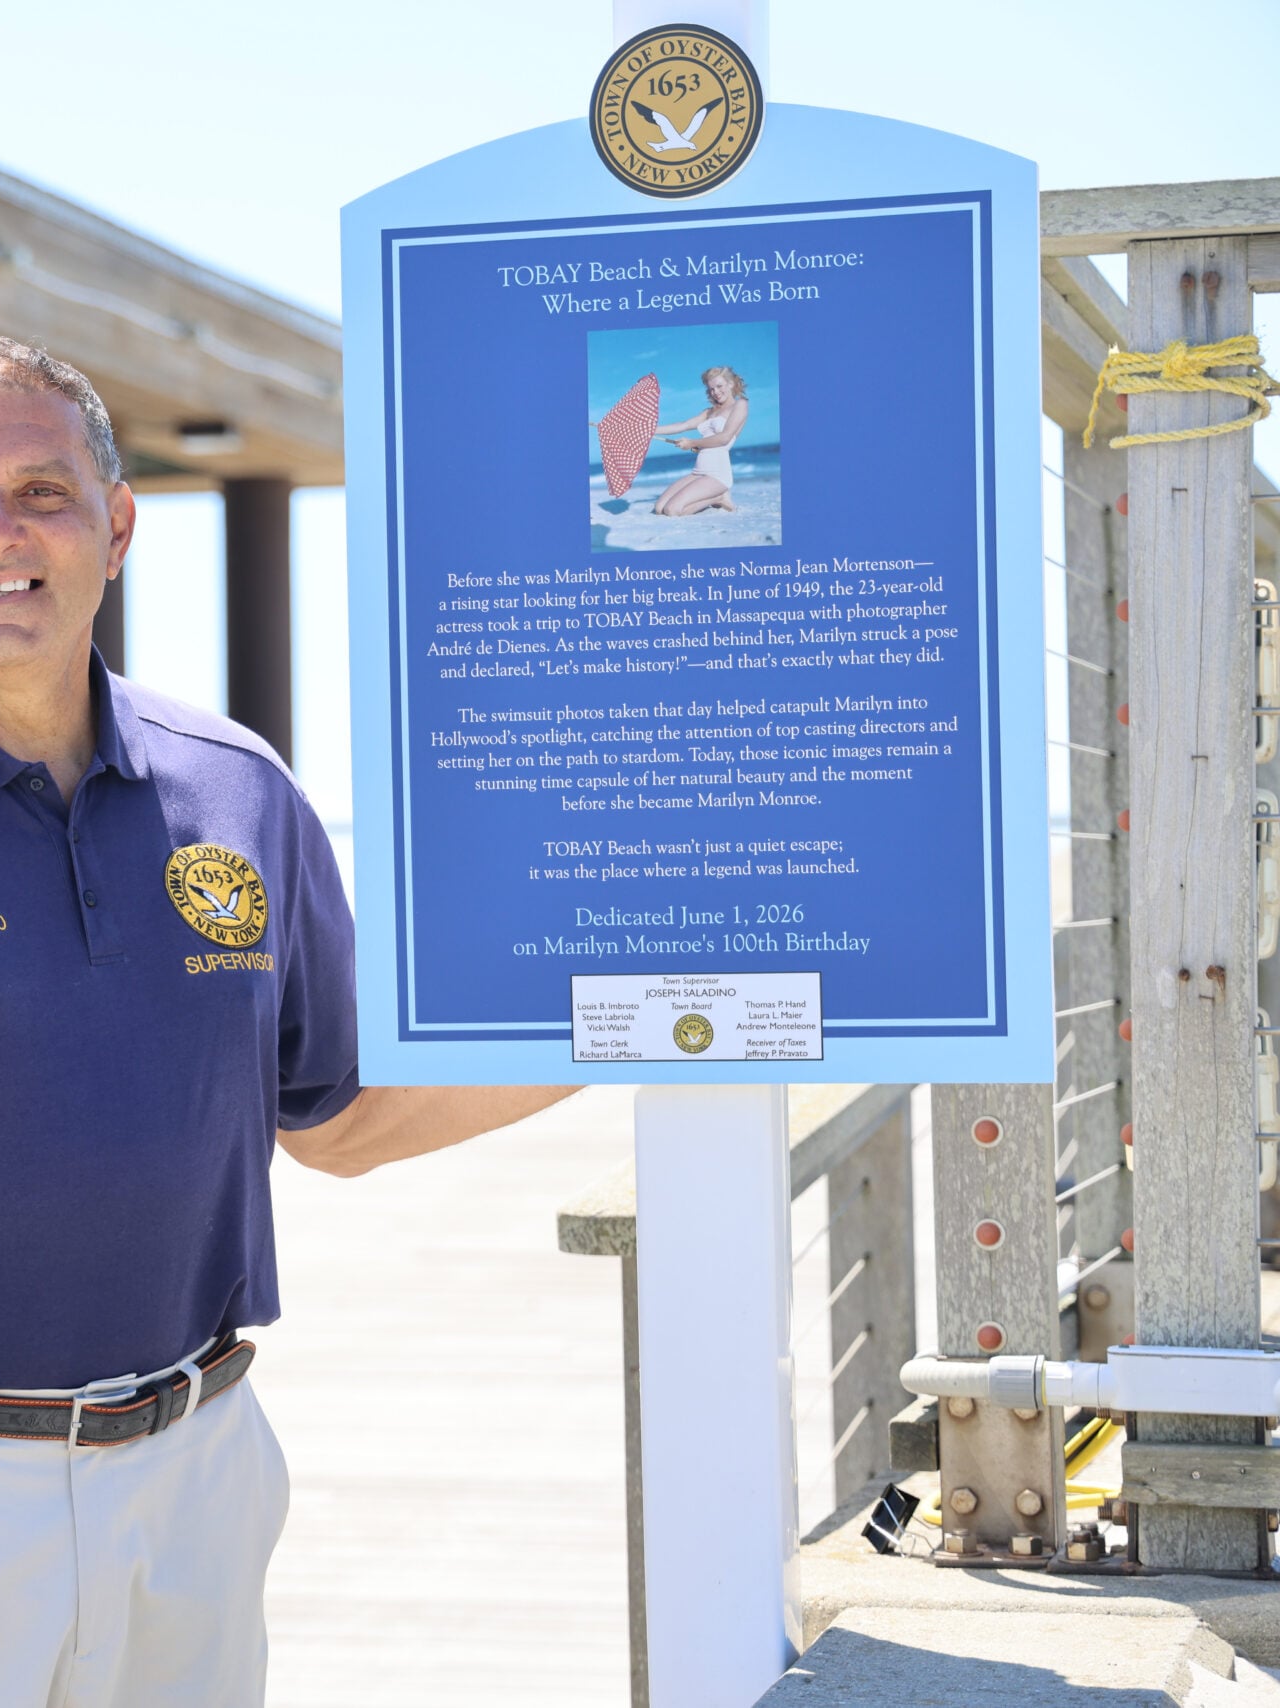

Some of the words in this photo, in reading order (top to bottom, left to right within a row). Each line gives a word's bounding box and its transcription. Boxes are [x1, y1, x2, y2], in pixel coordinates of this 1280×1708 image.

[605, 73, 629, 141] TOWN
[627, 47, 652, 73] OF
[660, 39, 738, 84] OYSTER
[729, 87, 746, 130] BAY
[647, 69, 700, 103] 1653
[622, 152, 670, 184] NEW
[675, 147, 730, 184] YORK
[497, 263, 582, 287] TOBAY
[588, 258, 652, 282] Beach
[659, 257, 680, 277] &
[686, 252, 767, 277] Marilyn
[774, 249, 863, 270] Monroe:
[542, 292, 611, 314] Where
[618, 297, 629, 310] a
[636, 284, 711, 312] Legend
[717, 283, 761, 304] Was
[768, 280, 820, 301] Born
[447, 571, 492, 588] Before
[496, 570, 520, 586] she
[524, 574, 550, 585] was
[554, 567, 610, 585] Marilyn
[615, 566, 676, 581] Monroe,
[680, 563, 704, 579] she
[709, 566, 736, 577] was
[739, 561, 791, 576] Norma
[795, 559, 828, 577] Jean
[440, 662, 466, 678] and
[470, 660, 534, 678] declared,
[583, 657, 621, 674] make
[781, 650, 834, 669] exactly
[838, 648, 875, 665] what
[879, 647, 912, 666] they
[916, 645, 944, 663] did.
[457, 707, 487, 723] The
[491, 707, 552, 722] swimsuit
[556, 704, 604, 724] photos
[609, 702, 649, 719] taken
[653, 701, 683, 717] that
[687, 700, 712, 719] day
[716, 698, 766, 718] helped
[770, 696, 830, 716] catapult
[834, 694, 893, 714] Marilyn
[897, 696, 928, 709] into
[521, 727, 587, 747] spotlight,
[591, 725, 653, 744] catching
[657, 724, 680, 740] the
[685, 724, 752, 739] attention
[756, 721, 773, 737] of
[775, 725, 800, 740] top
[803, 721, 856, 738] casting
[860, 718, 925, 734] directors
[929, 715, 958, 732] and
[475, 776, 537, 792] stunning
[541, 775, 572, 789] time
[576, 771, 629, 791] capsule
[633, 770, 649, 786] of
[652, 770, 676, 786] her
[680, 768, 732, 785] natural
[736, 768, 785, 785] beauty
[789, 766, 817, 782] and
[822, 765, 846, 781] the
[850, 767, 912, 781] moment
[561, 795, 606, 811] before
[610, 794, 634, 810] she
[638, 793, 693, 809] became
[697, 791, 754, 810] Marilyn
[759, 790, 821, 806] Monroe.
[176, 850, 192, 866] OF
[543, 840, 603, 856] TOBAY
[607, 839, 651, 855] Beach
[704, 839, 731, 856] just
[735, 842, 744, 852] a
[748, 838, 785, 856] quiet
[790, 840, 843, 854] escape;
[195, 846, 249, 876] OYSTER
[529, 866, 539, 879] it
[543, 869, 570, 879] was
[574, 863, 597, 879] the
[601, 862, 639, 882] place
[643, 861, 687, 877] where
[691, 866, 699, 876] a
[703, 859, 752, 879] legend
[755, 864, 782, 875] was
[787, 857, 859, 874] launched.
[169, 865, 190, 910] TOWN
[193, 864, 234, 888] 1653
[247, 880, 265, 916] BAY
[575, 905, 674, 926] Dedicated
[679, 906, 724, 929] June
[733, 905, 748, 926] 1,
[756, 903, 804, 923] 2026
[193, 917, 228, 941] NEW
[230, 921, 260, 943] YORK
[513, 943, 538, 955] on
[543, 934, 619, 958] Marilyn
[625, 933, 714, 954] Monroe's
[723, 932, 778, 952] 100th
[785, 930, 870, 955] Birthday
[662, 977, 681, 985] Town
[682, 977, 720, 985] Supervisor
[577, 1002, 597, 1010] Louis
[599, 1002, 606, 1010] B.
[608, 1002, 640, 1010] Imbroto
[645, 989, 681, 1000] JOSEPH
[683, 988, 737, 997] SALADINO
[671, 1002, 690, 1010] Town
[691, 1002, 713, 1010] Board
[745, 1000, 776, 1009] Thomas
[785, 1000, 807, 1008] Hand
[582, 1013, 603, 1021] Steve
[604, 1013, 635, 1021] Labriola
[736, 1022, 767, 1031] Andrew
[769, 1022, 816, 1030] Monteleone
[748, 1011, 770, 1020] Laura
[780, 1011, 803, 1019] Maier
[587, 1024, 606, 1032] Vicki
[605, 1024, 631, 1032] Walsh
[579, 1051, 608, 1059] Richard
[610, 1050, 642, 1059] LaMarca
[590, 1040, 608, 1048] Town
[610, 1040, 629, 1048] Clerk
[745, 1049, 769, 1059] Jeffrey
[771, 1049, 777, 1057] P.
[778, 1049, 808, 1057] Pravato
[746, 1038, 777, 1046] Receiver
[778, 1038, 788, 1048] of
[787, 1038, 807, 1046] Taxes
